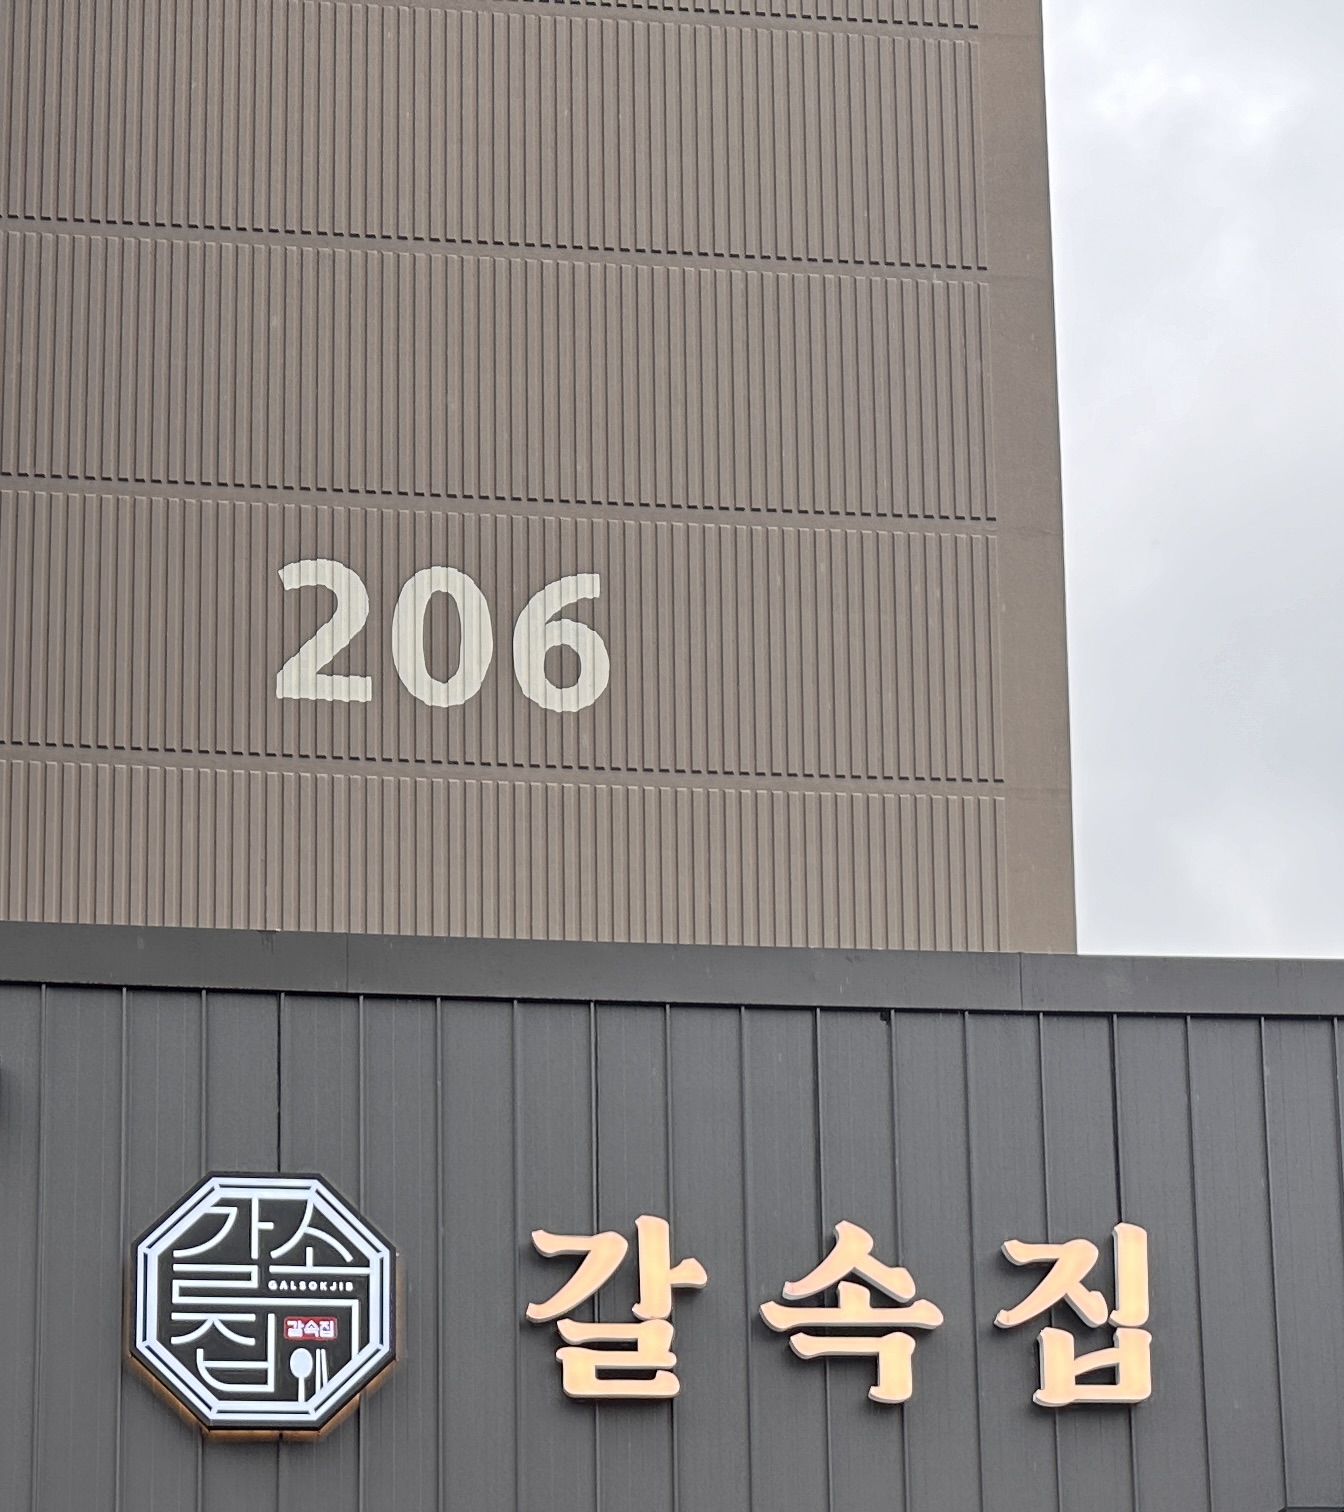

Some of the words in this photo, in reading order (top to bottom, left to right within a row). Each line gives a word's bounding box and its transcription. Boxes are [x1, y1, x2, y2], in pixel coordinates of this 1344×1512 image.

[275, 558, 610, 713] 206
[268, 1281, 354, 1291] GALSOKJIB
[286, 1319, 335, 1338] 갈속집
[526, 1214, 1153, 1407] 갈속집
